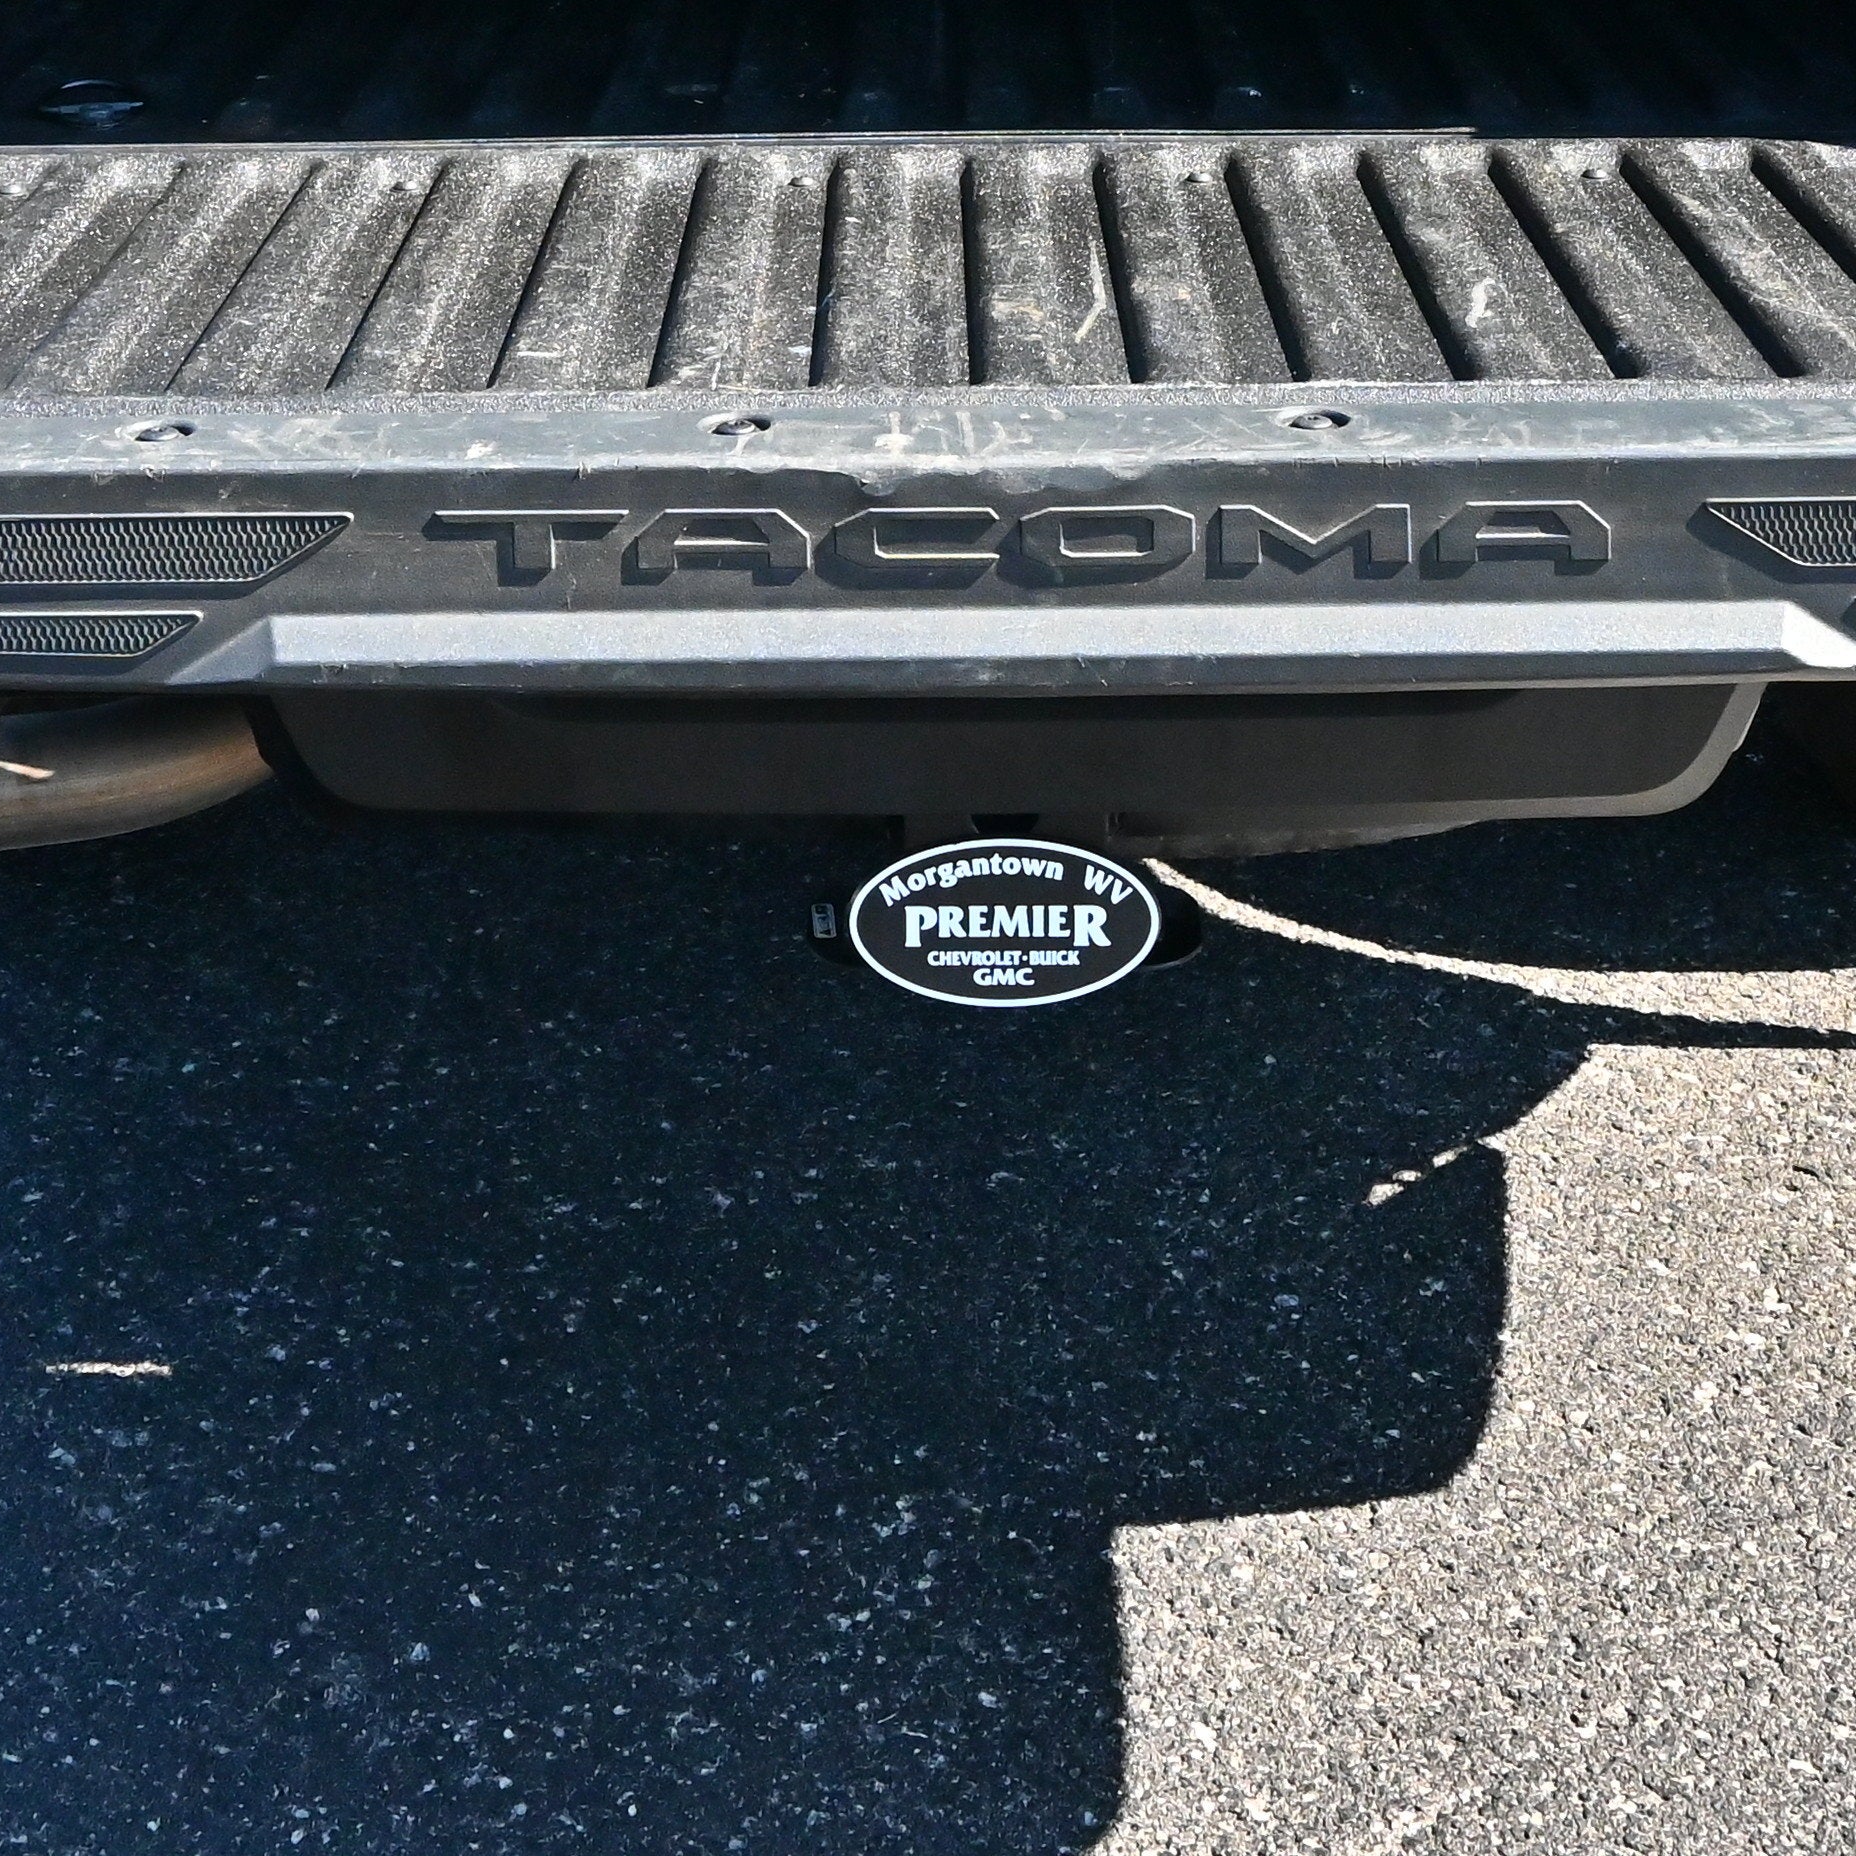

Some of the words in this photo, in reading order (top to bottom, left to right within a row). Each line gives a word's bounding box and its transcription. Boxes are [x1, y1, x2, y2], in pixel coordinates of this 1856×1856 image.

[429, 499, 1613, 582] TACOMA
[878, 852, 1065, 907] Morgantown
[1083, 863, 1134, 905] WV
[904, 904, 1112, 948] PREMIER
[973, 968, 1035, 986] GMC
